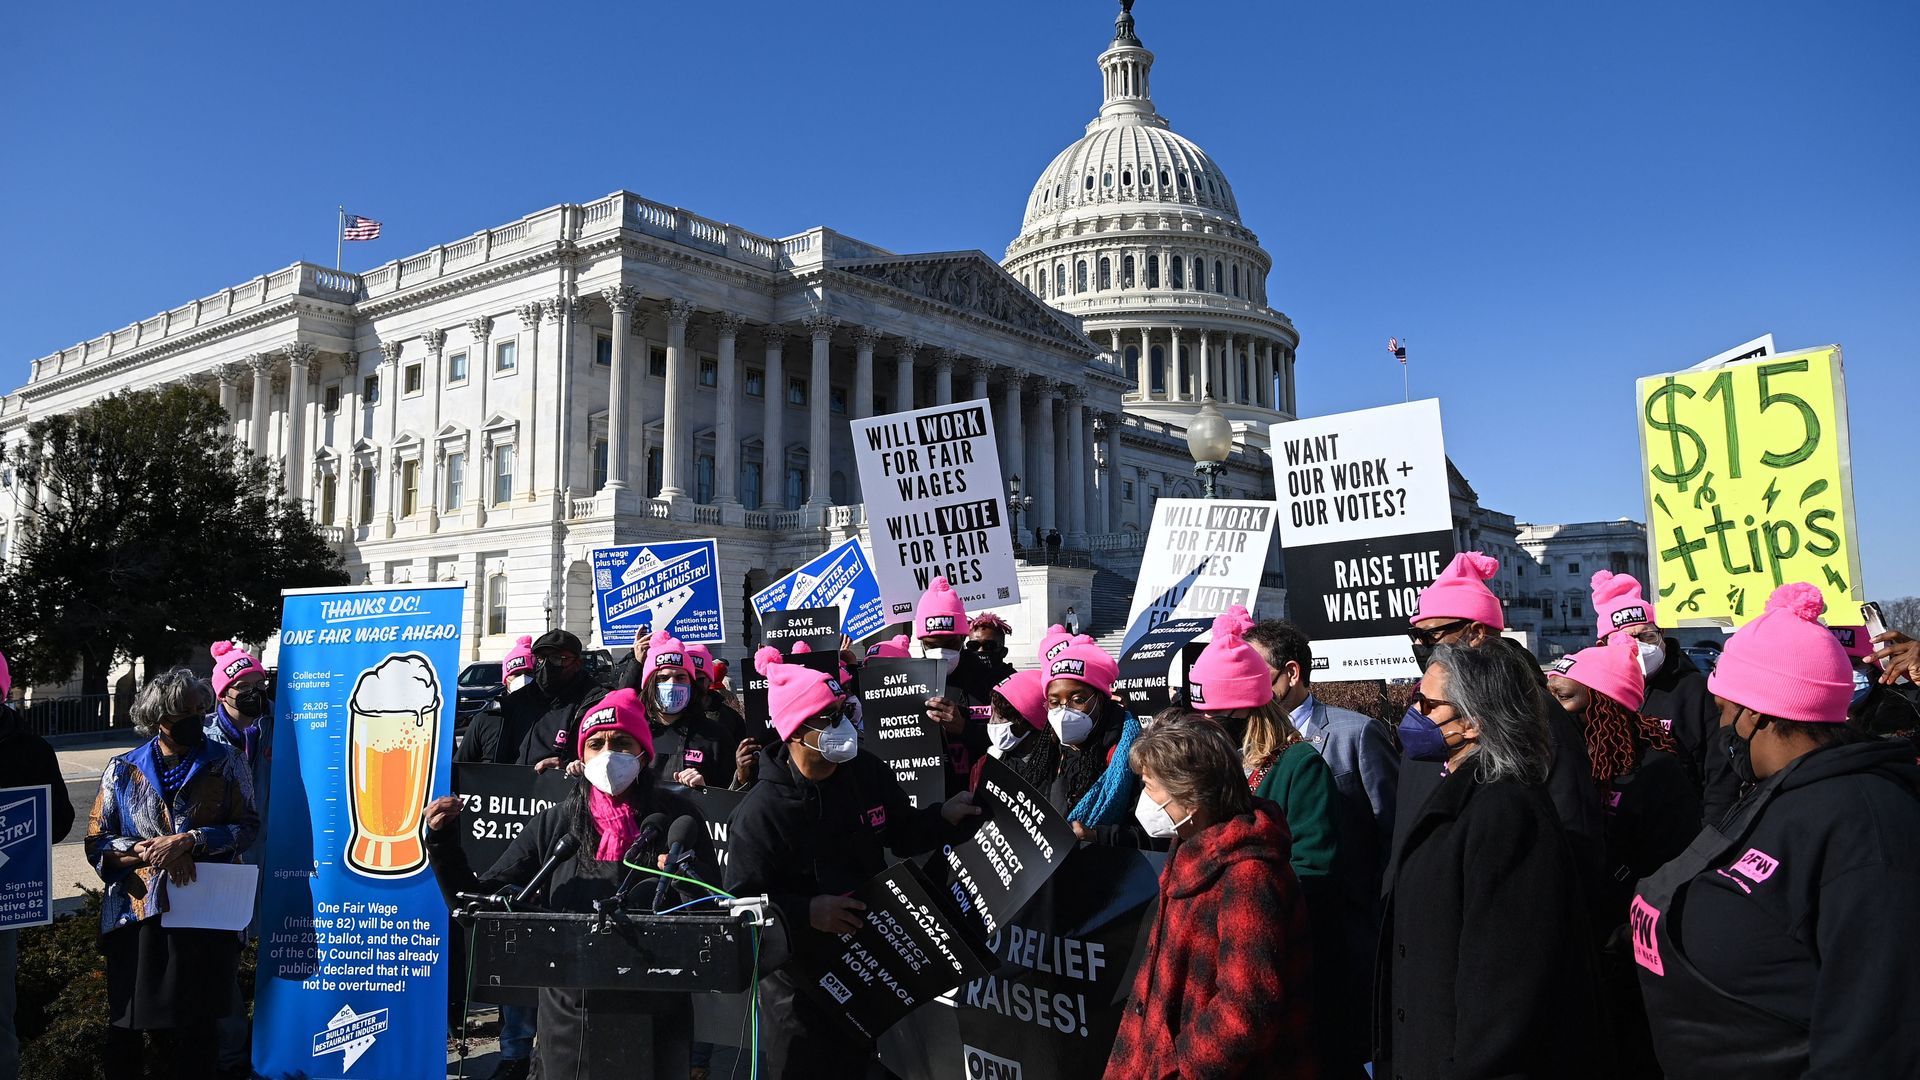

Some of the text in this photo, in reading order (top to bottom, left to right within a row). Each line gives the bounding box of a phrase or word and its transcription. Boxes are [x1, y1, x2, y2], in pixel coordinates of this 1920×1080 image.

[866, 410, 981, 451] WILL WORK
[1645, 359, 1821, 492] $15
[882, 440, 974, 477] FOR FAIR
[1285, 434, 1338, 466] WANT
[897, 469, 967, 501] WAGES
[1288, 458, 1389, 497] OUR WORK
[1164, 507, 1265, 530] WILL WORK
[1291, 488, 1406, 528] OUR VOTES?
[886, 501, 993, 540] WILL VOTE
[898, 531, 990, 567] FOR FAIR
[1167, 530, 1248, 552] FOR FAIR
[1660, 504, 1840, 586] +tips
[596, 558, 627, 568] plus tips.
[610, 551, 629, 560] wage
[638, 554, 651, 565] DC
[1171, 554, 1232, 577] WAGES
[627, 560, 657, 577] COMMITTEE
[1335, 551, 1440, 589] RAISE THE
[621, 560, 691, 599] BUILD A BETTER
[796, 576, 808, 590] DC
[816, 565, 845, 595] BETTER
[824, 561, 859, 602] INDUSTRY
[608, 564, 707, 617] RESTAURANT INDUSTRY
[756, 584, 787, 605] Fair wage
[790, 580, 813, 606] COMMITTEE
[1196, 588, 1243, 611] VOTE
[321, 595, 421, 620] THANKS DC!
[759, 592, 788, 613] plus tips.
[1323, 591, 1381, 622] WAGE
[693, 610, 706, 618] Sign
[788, 618, 813, 627] SAVE
[847, 610, 868, 625] petition
[848, 613, 878, 632] Initiative
[926, 617, 953, 626] OFW
[1612, 606, 1644, 622] OFW
[283, 624, 460, 645] ONE FAIR WAGE AHEAD.
[674, 624, 708, 633] Initiative
[767, 627, 834, 639] RESTAURANTS.
[1047, 641, 1067, 660] OFW
[1131, 650, 1166, 660] WORKERS.
[1139, 641, 1175, 651] PROTECT
[225, 658, 249, 675] OFW
[656, 654, 682, 664] OFW
[1052, 660, 1083, 670] OFW
[287, 680, 330, 690] signatures
[293, 671, 330, 680] Collected
[884, 674, 907, 685] SAVE
[1112, 676, 1166, 690] ONE FAIR WAGE
[865, 684, 929, 700] RESTAURANTS.
[1129, 691, 1150, 701] NOW.
[285, 712, 328, 721] signatures
[303, 702, 328, 711] 26,205
[310, 720, 327, 730] goal
[583, 708, 614, 727] OFW
[880, 714, 919, 727] PROTECT
[879, 727, 924, 740] WORKERS.
[890, 756, 940, 769] FAIR WAGE
[1016, 791, 1046, 825] SAVE
[472, 818, 523, 839] $2.13
[985, 780, 1054, 864] RESTAURANTS.
[985, 820, 1024, 874] PROTECT
[973, 828, 1013, 891] WORKERS.
[1741, 853, 1773, 875] OFW
[274, 869, 319, 879] signatures
[5, 882, 26, 891] Sign
[27, 889, 43, 898] put
[943, 844, 962, 871] ONE
[957, 867, 978, 896] FAIR
[974, 894, 997, 934] WAGE
[28, 899, 43, 908] 82
[317, 902, 398, 916] One Fair Wage
[950, 881, 971, 917] NOW.
[14, 911, 43, 920] ballot.
[284, 916, 430, 930] (Initiative 82) will be on the
[919, 904, 950, 941] SAVE
[879, 909, 932, 965] PROTECT
[885, 879, 963, 975] RESTAURANTS.
[270, 932, 441, 946] June 2022 ballot, and the Chair
[866, 911, 921, 975] WORKERS.
[270, 947, 440, 965] of the City Council has already
[1007, 925, 1105, 981] RELIEF
[279, 963, 431, 977] publicly declared that it will
[841, 952, 875, 987] NOW.
[850, 942, 879, 970] FAIR
[877, 968, 915, 1006] WAGE
[303, 979, 406, 992] not be overturned!
[825, 974, 850, 1000] OFW
[967, 975, 1088, 1037] RAISES!
[315, 1020, 387, 1052] RESTAURANT INDUSTRY
[326, 1017, 376, 1040] BUILD BETTER
[968, 1051, 1017, 1080] OFW
